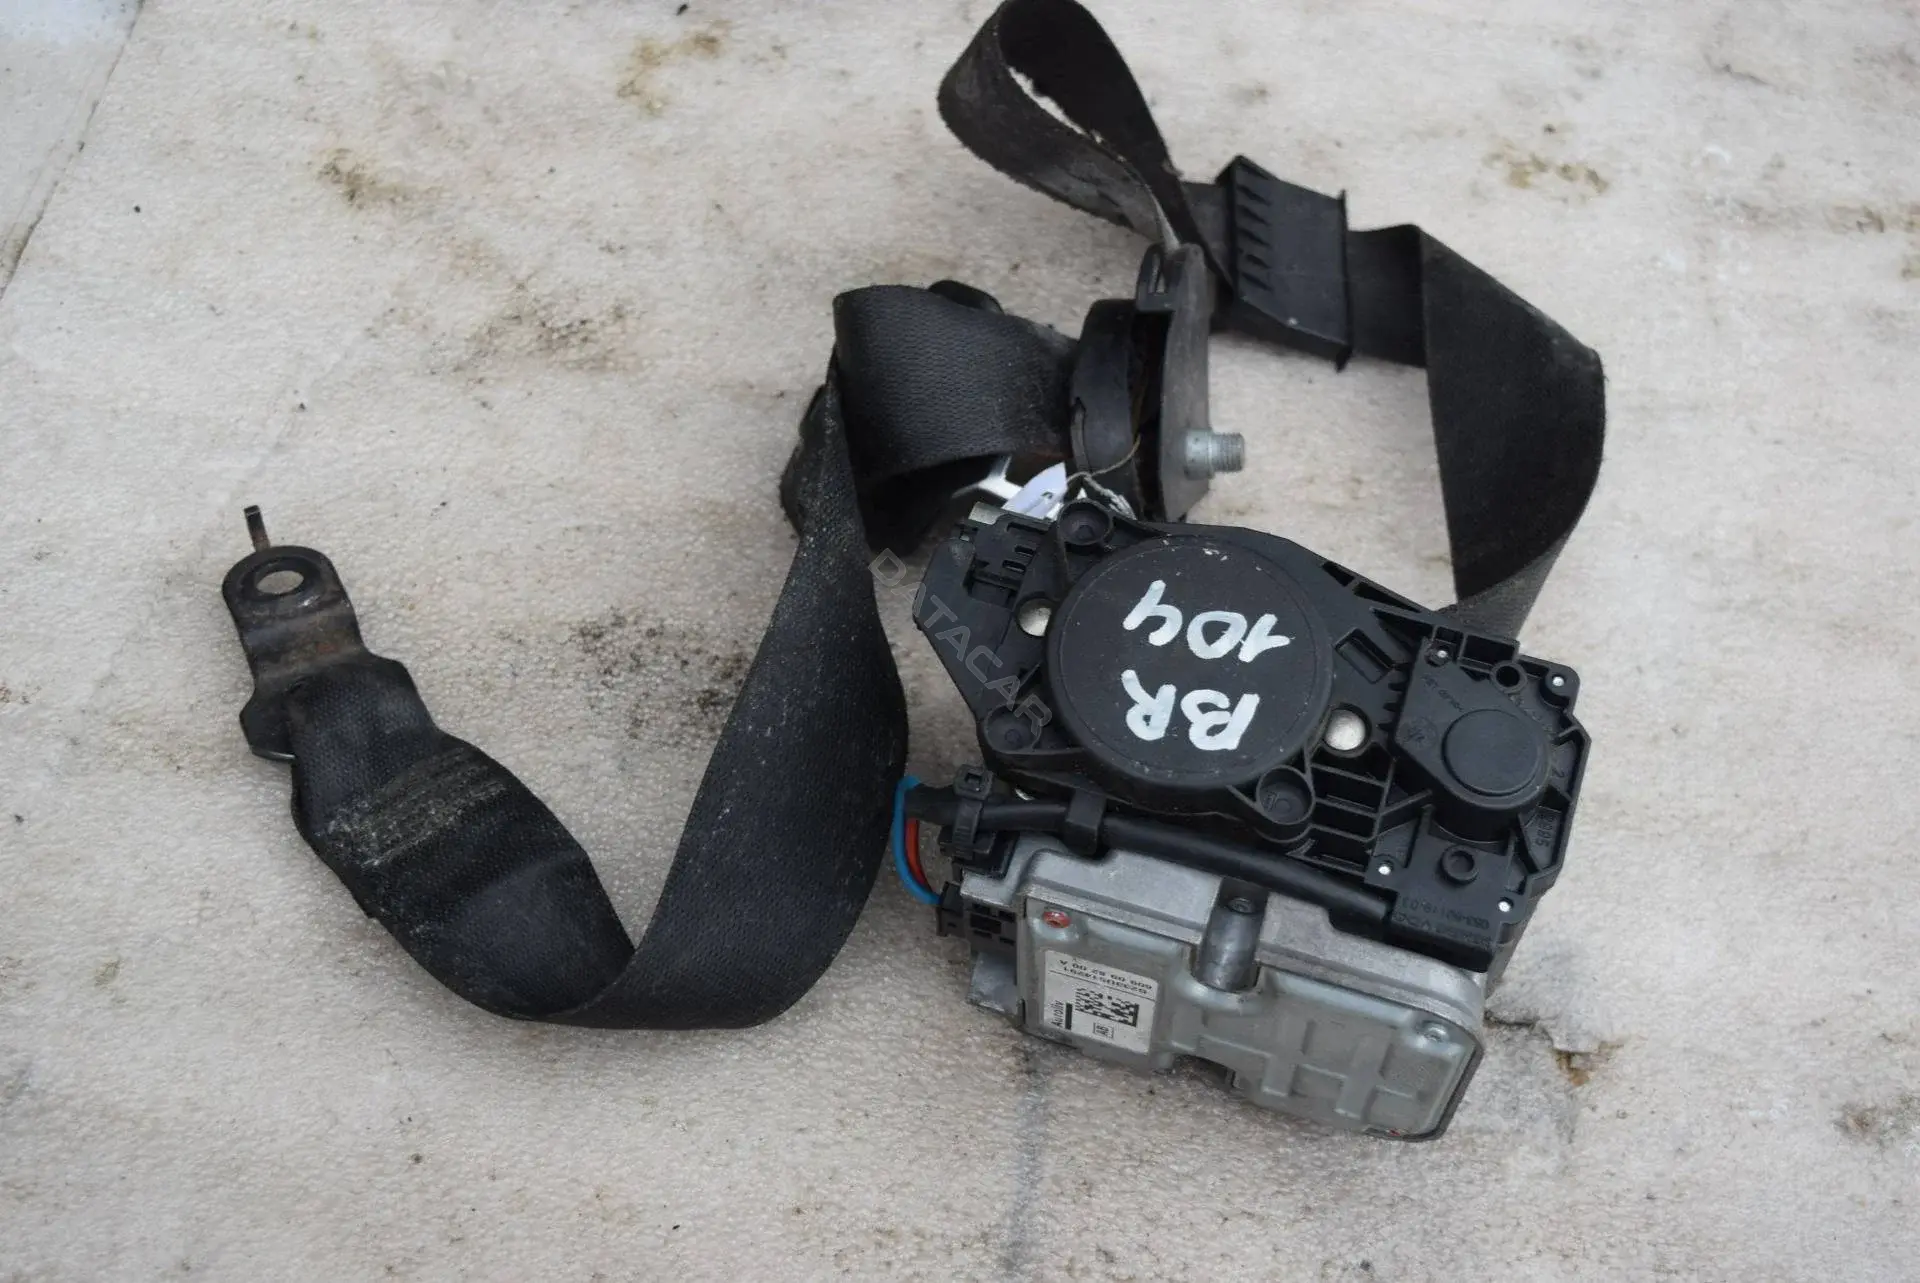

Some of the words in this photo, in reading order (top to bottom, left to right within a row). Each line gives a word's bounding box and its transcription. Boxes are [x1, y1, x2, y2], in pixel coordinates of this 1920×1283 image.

[1123, 580, 1291, 662] 104
[1121, 669, 1261, 751] BR
[1051, 1000, 1064, 1028] Autoliv
